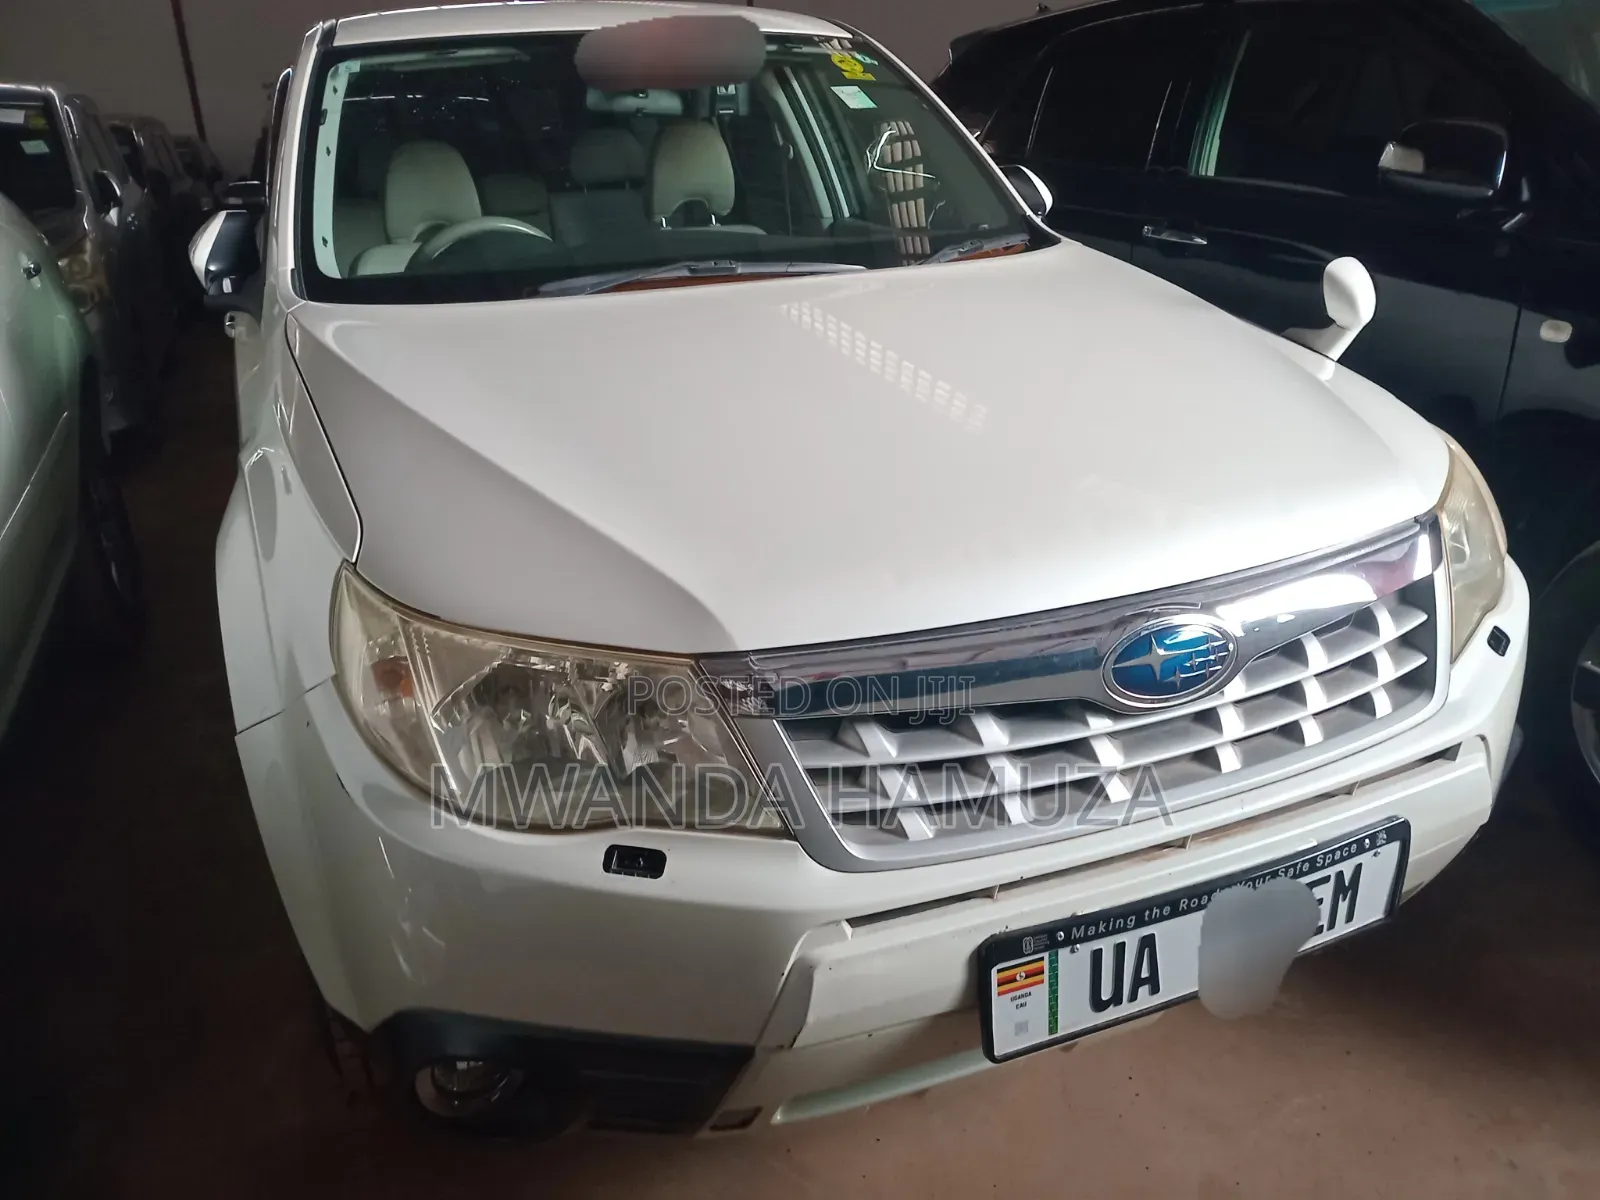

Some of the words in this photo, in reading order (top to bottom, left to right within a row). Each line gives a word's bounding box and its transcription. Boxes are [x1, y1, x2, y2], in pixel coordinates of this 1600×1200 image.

[1071, 917, 1135, 940] Making
[1144, 906, 1170, 921] the
[1278, 861, 1310, 878] Safe
[1316, 843, 1357, 868] Space
[1089, 933, 1161, 1013] UA
